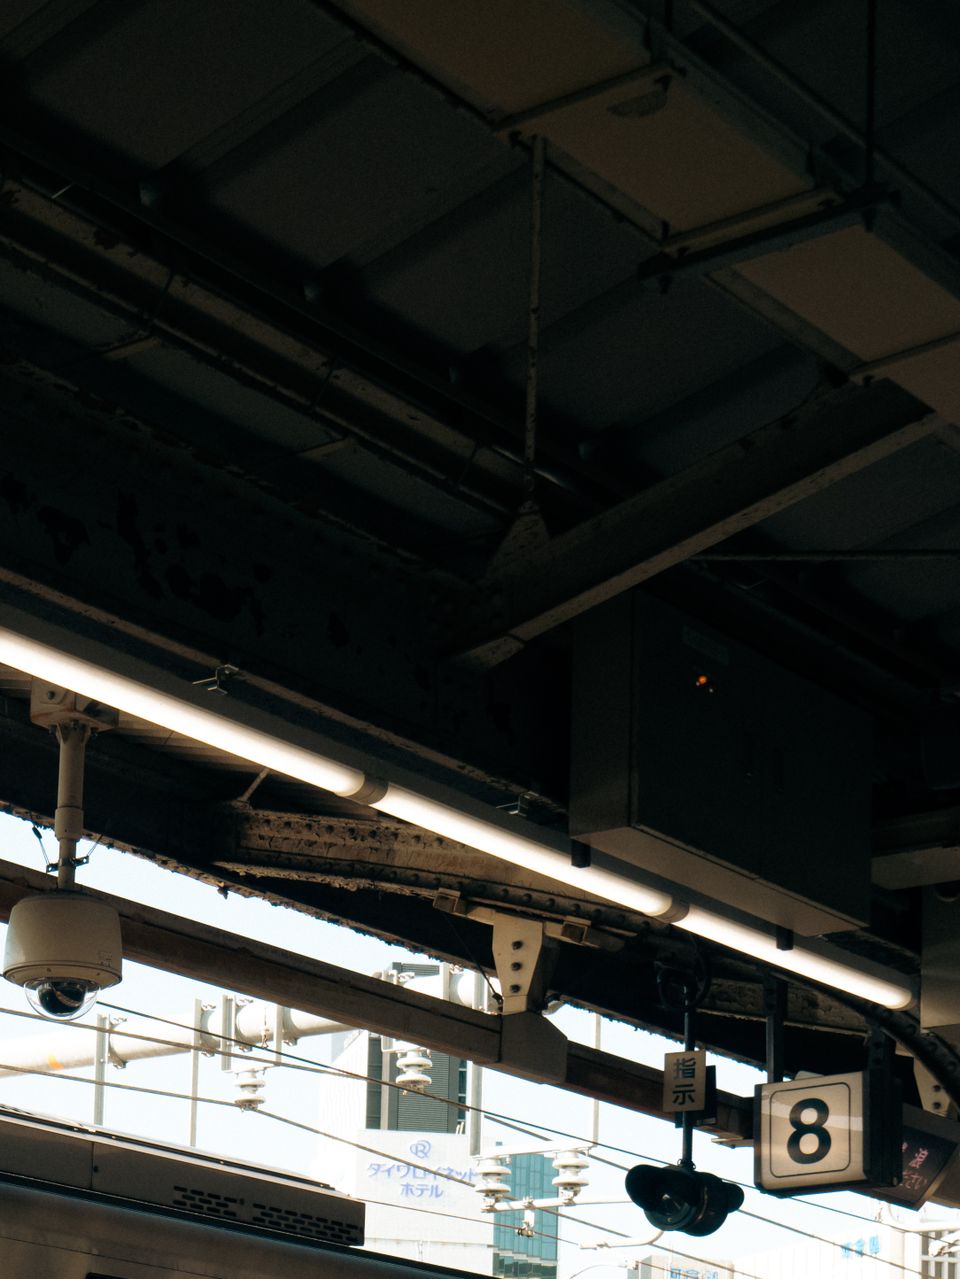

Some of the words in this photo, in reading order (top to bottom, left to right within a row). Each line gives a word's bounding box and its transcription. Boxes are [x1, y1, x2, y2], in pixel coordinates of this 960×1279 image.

[672, 1057, 696, 1105] 指示
[787, 1098, 832, 1165] 8
[400, 1182, 444, 1198] ホテル
